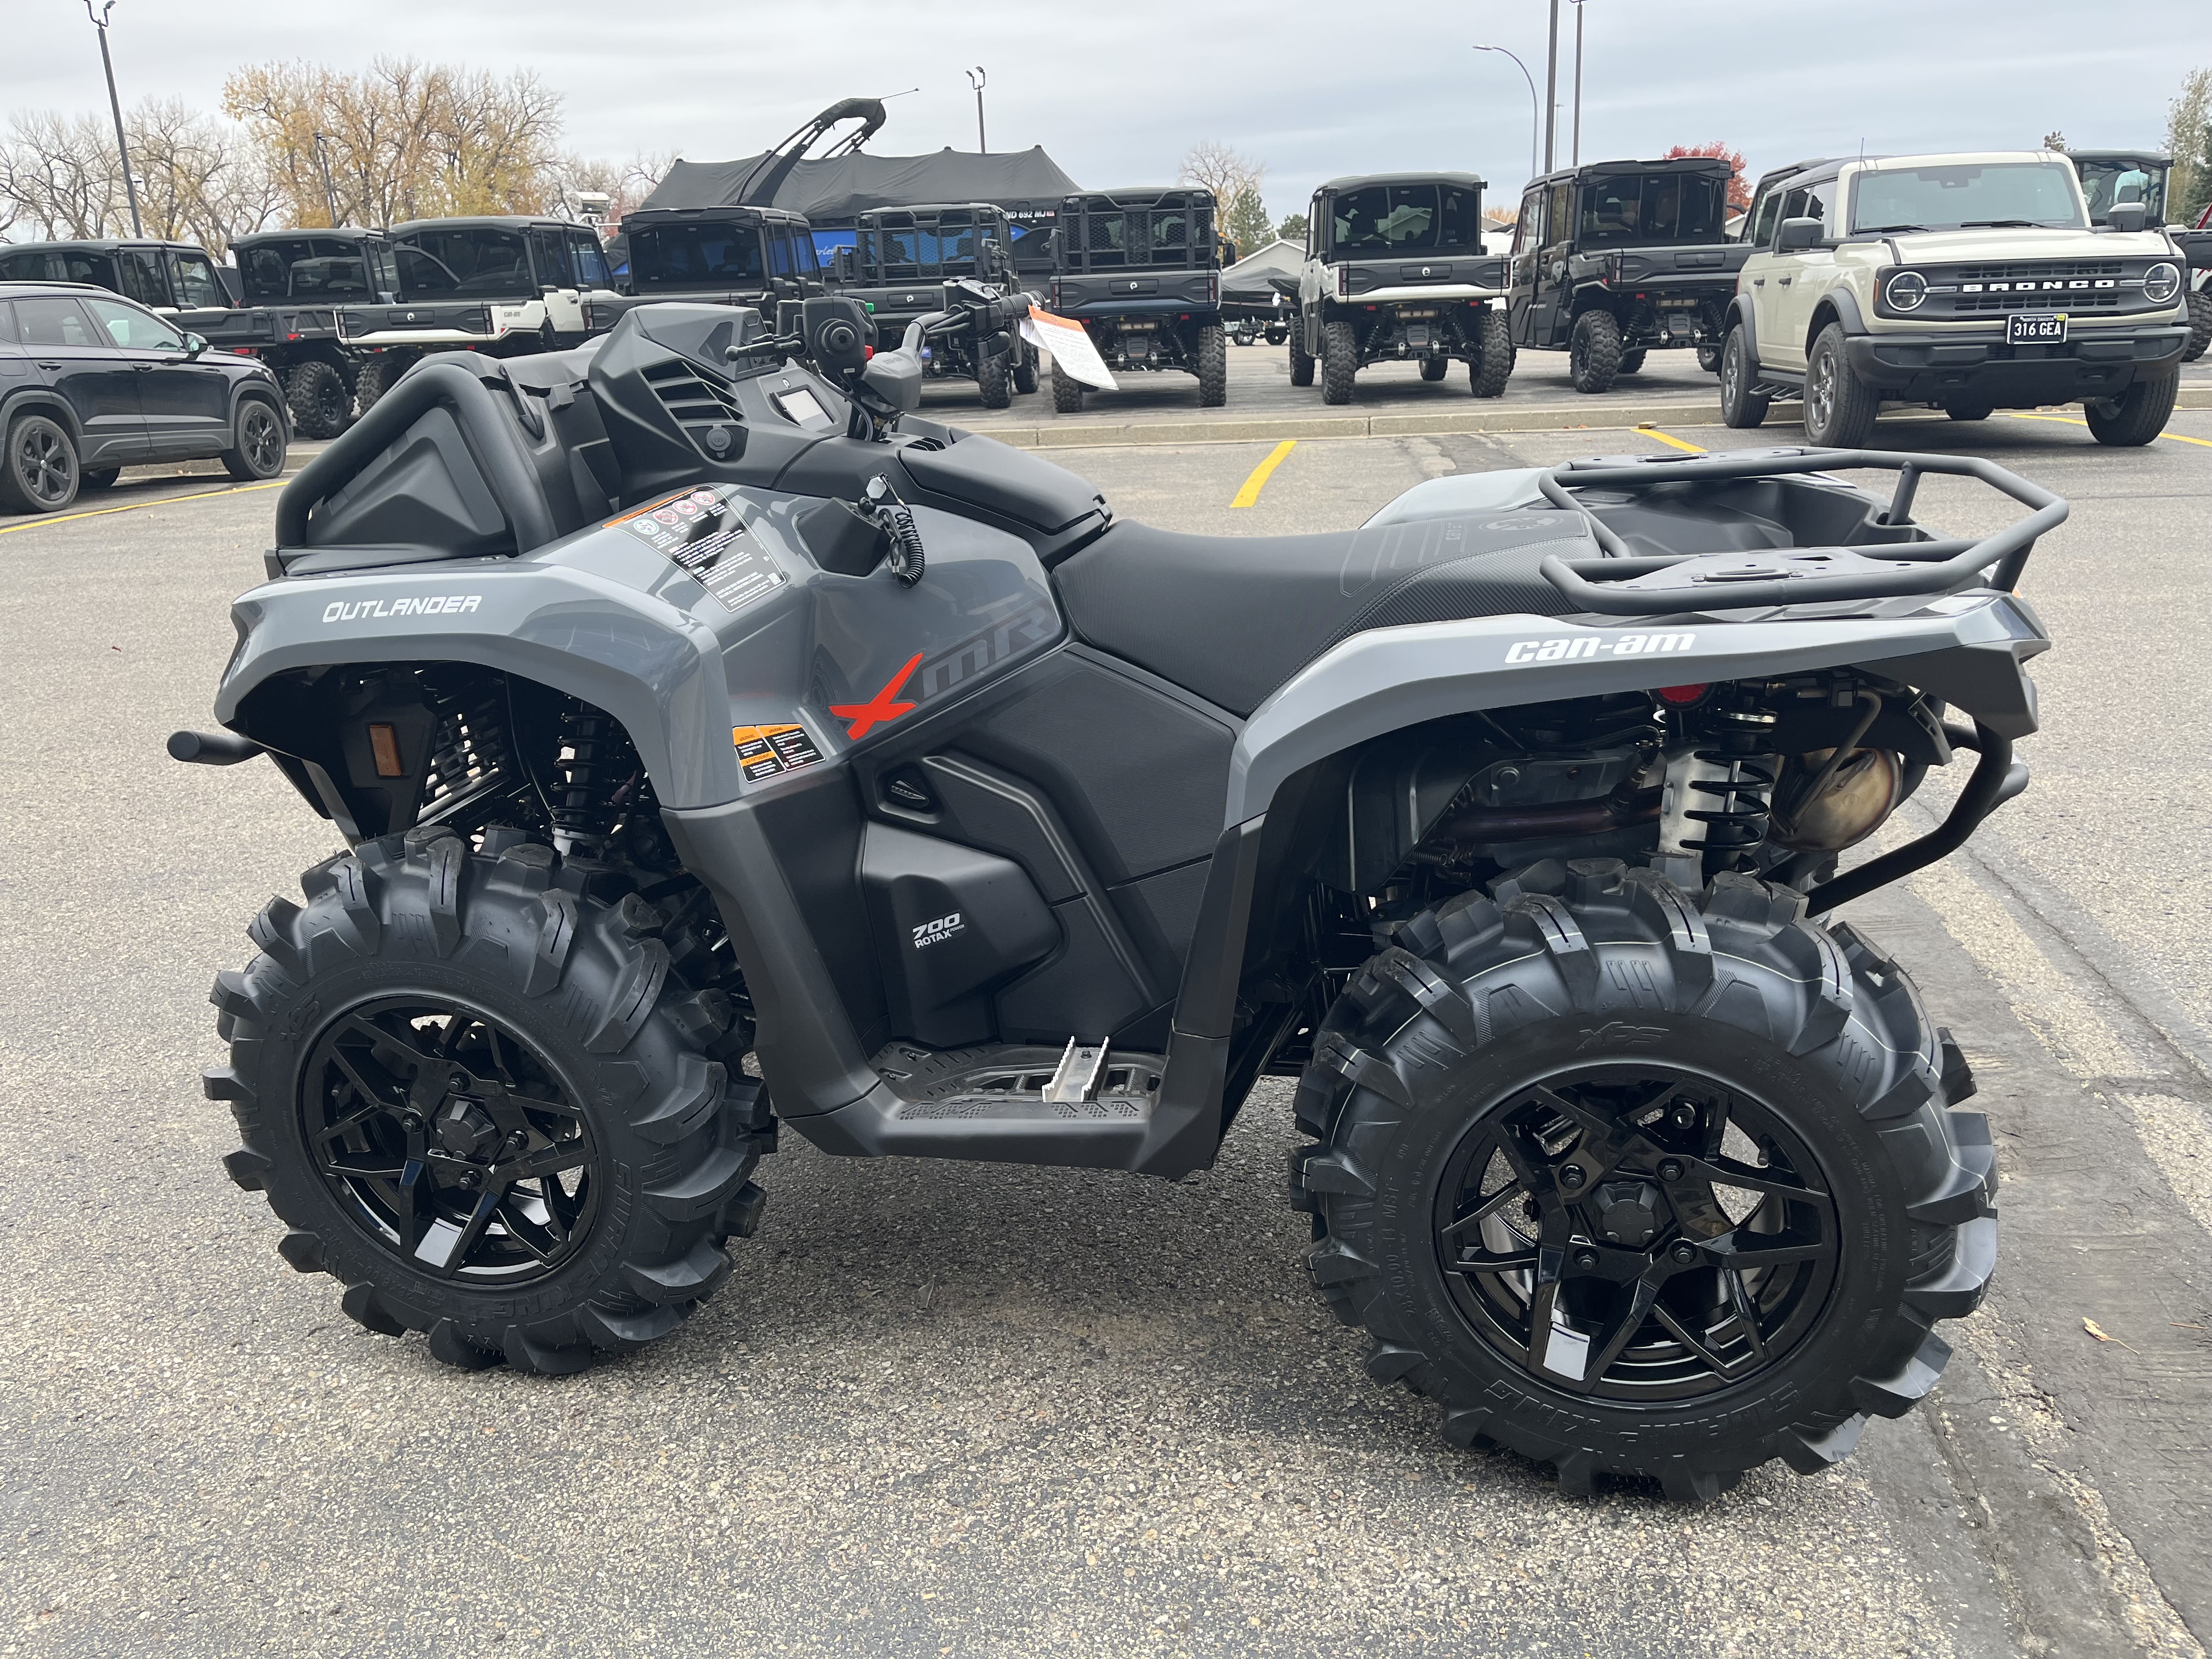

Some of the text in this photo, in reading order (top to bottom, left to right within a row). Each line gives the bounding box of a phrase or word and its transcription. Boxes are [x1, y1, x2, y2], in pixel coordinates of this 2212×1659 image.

[1006, 211, 1017, 219] ND
[1962, 279, 2114, 292] BRONCO
[2014, 321, 2061, 336] 316 GEA
[323, 595, 482, 623] OUTLANDER
[1504, 633, 1696, 664] can-am
[912, 913, 960, 940] 700
[915, 924, 965, 949] ROTAX POWER
[1575, 1022, 1671, 1052] XPS
[490, 1284, 575, 1320] KING
